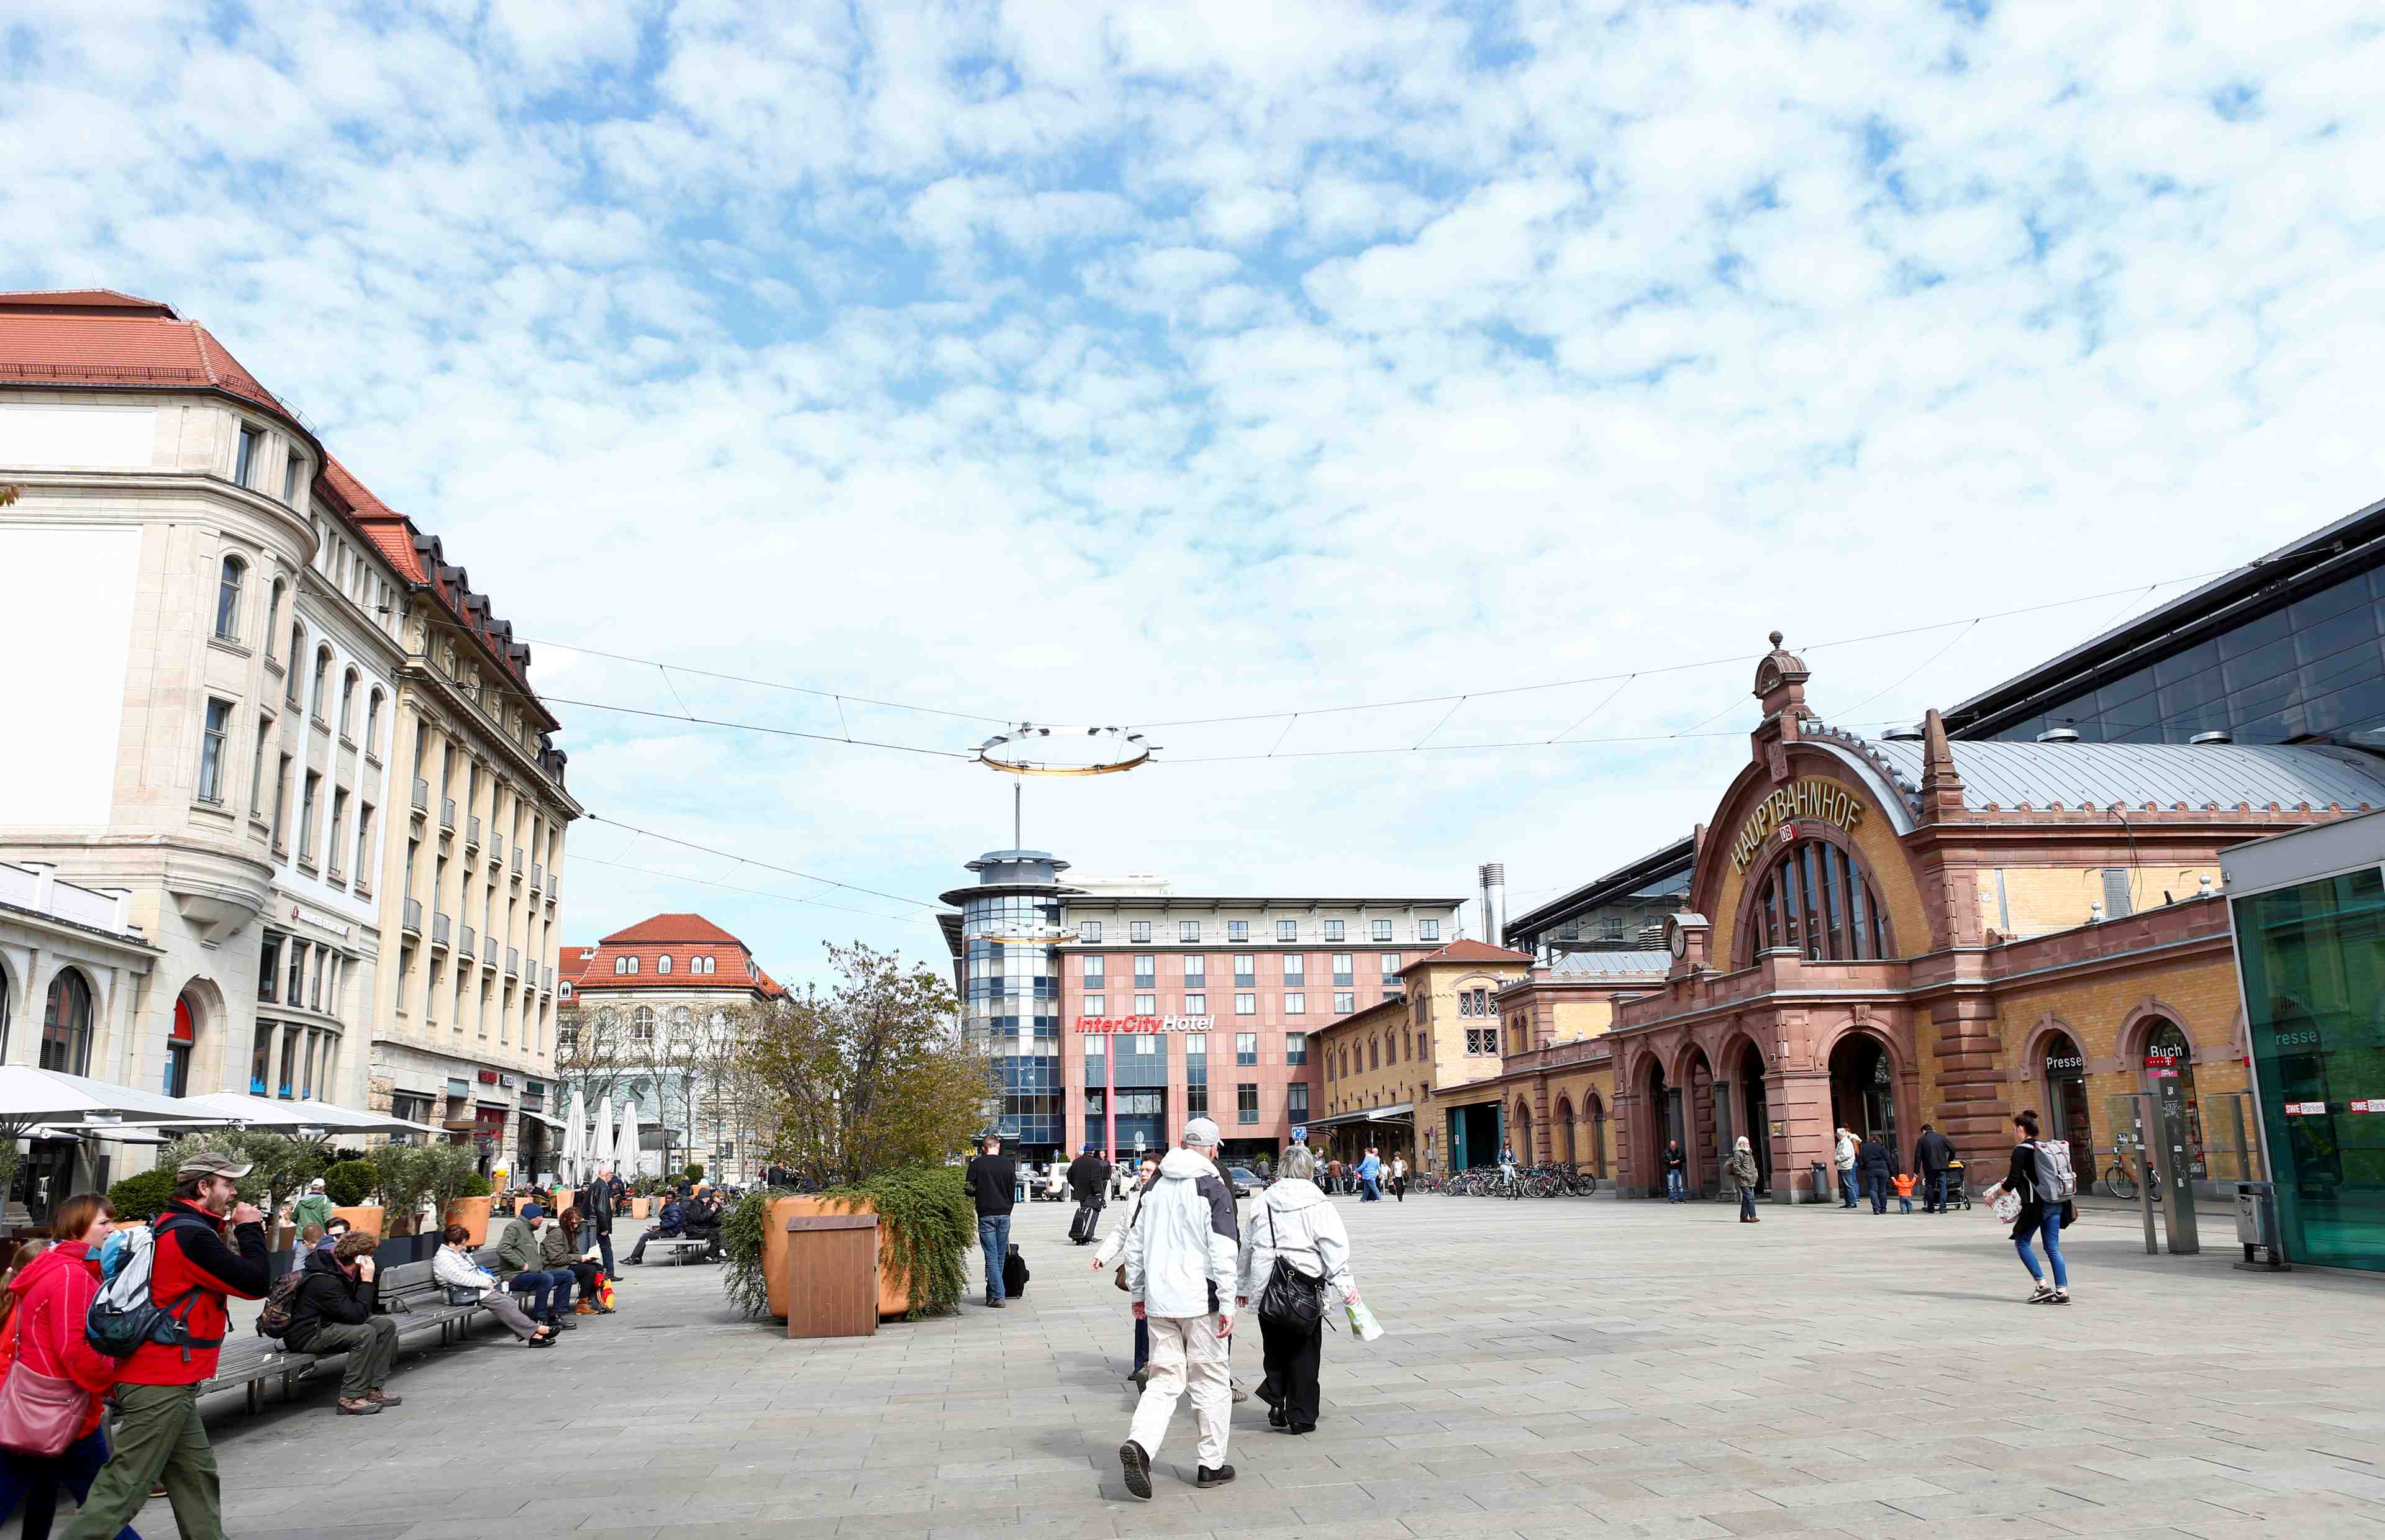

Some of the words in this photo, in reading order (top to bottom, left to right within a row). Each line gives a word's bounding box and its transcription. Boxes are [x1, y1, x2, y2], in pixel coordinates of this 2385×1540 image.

[1730, 781, 1860, 876] HAUPTBAHNHOF
[1780, 826, 1792, 841] DB
[1075, 1015, 1215, 1034] InterCityHotel
[2276, 1031, 2317, 1046] resse
[2150, 1043, 2183, 1058] Buch
[2047, 1056, 2083, 1069] Presse
[2286, 1105, 2301, 1113] SWE
[2302, 1104, 2324, 1113] Parken
[2351, 1102, 2368, 1111] SWE
